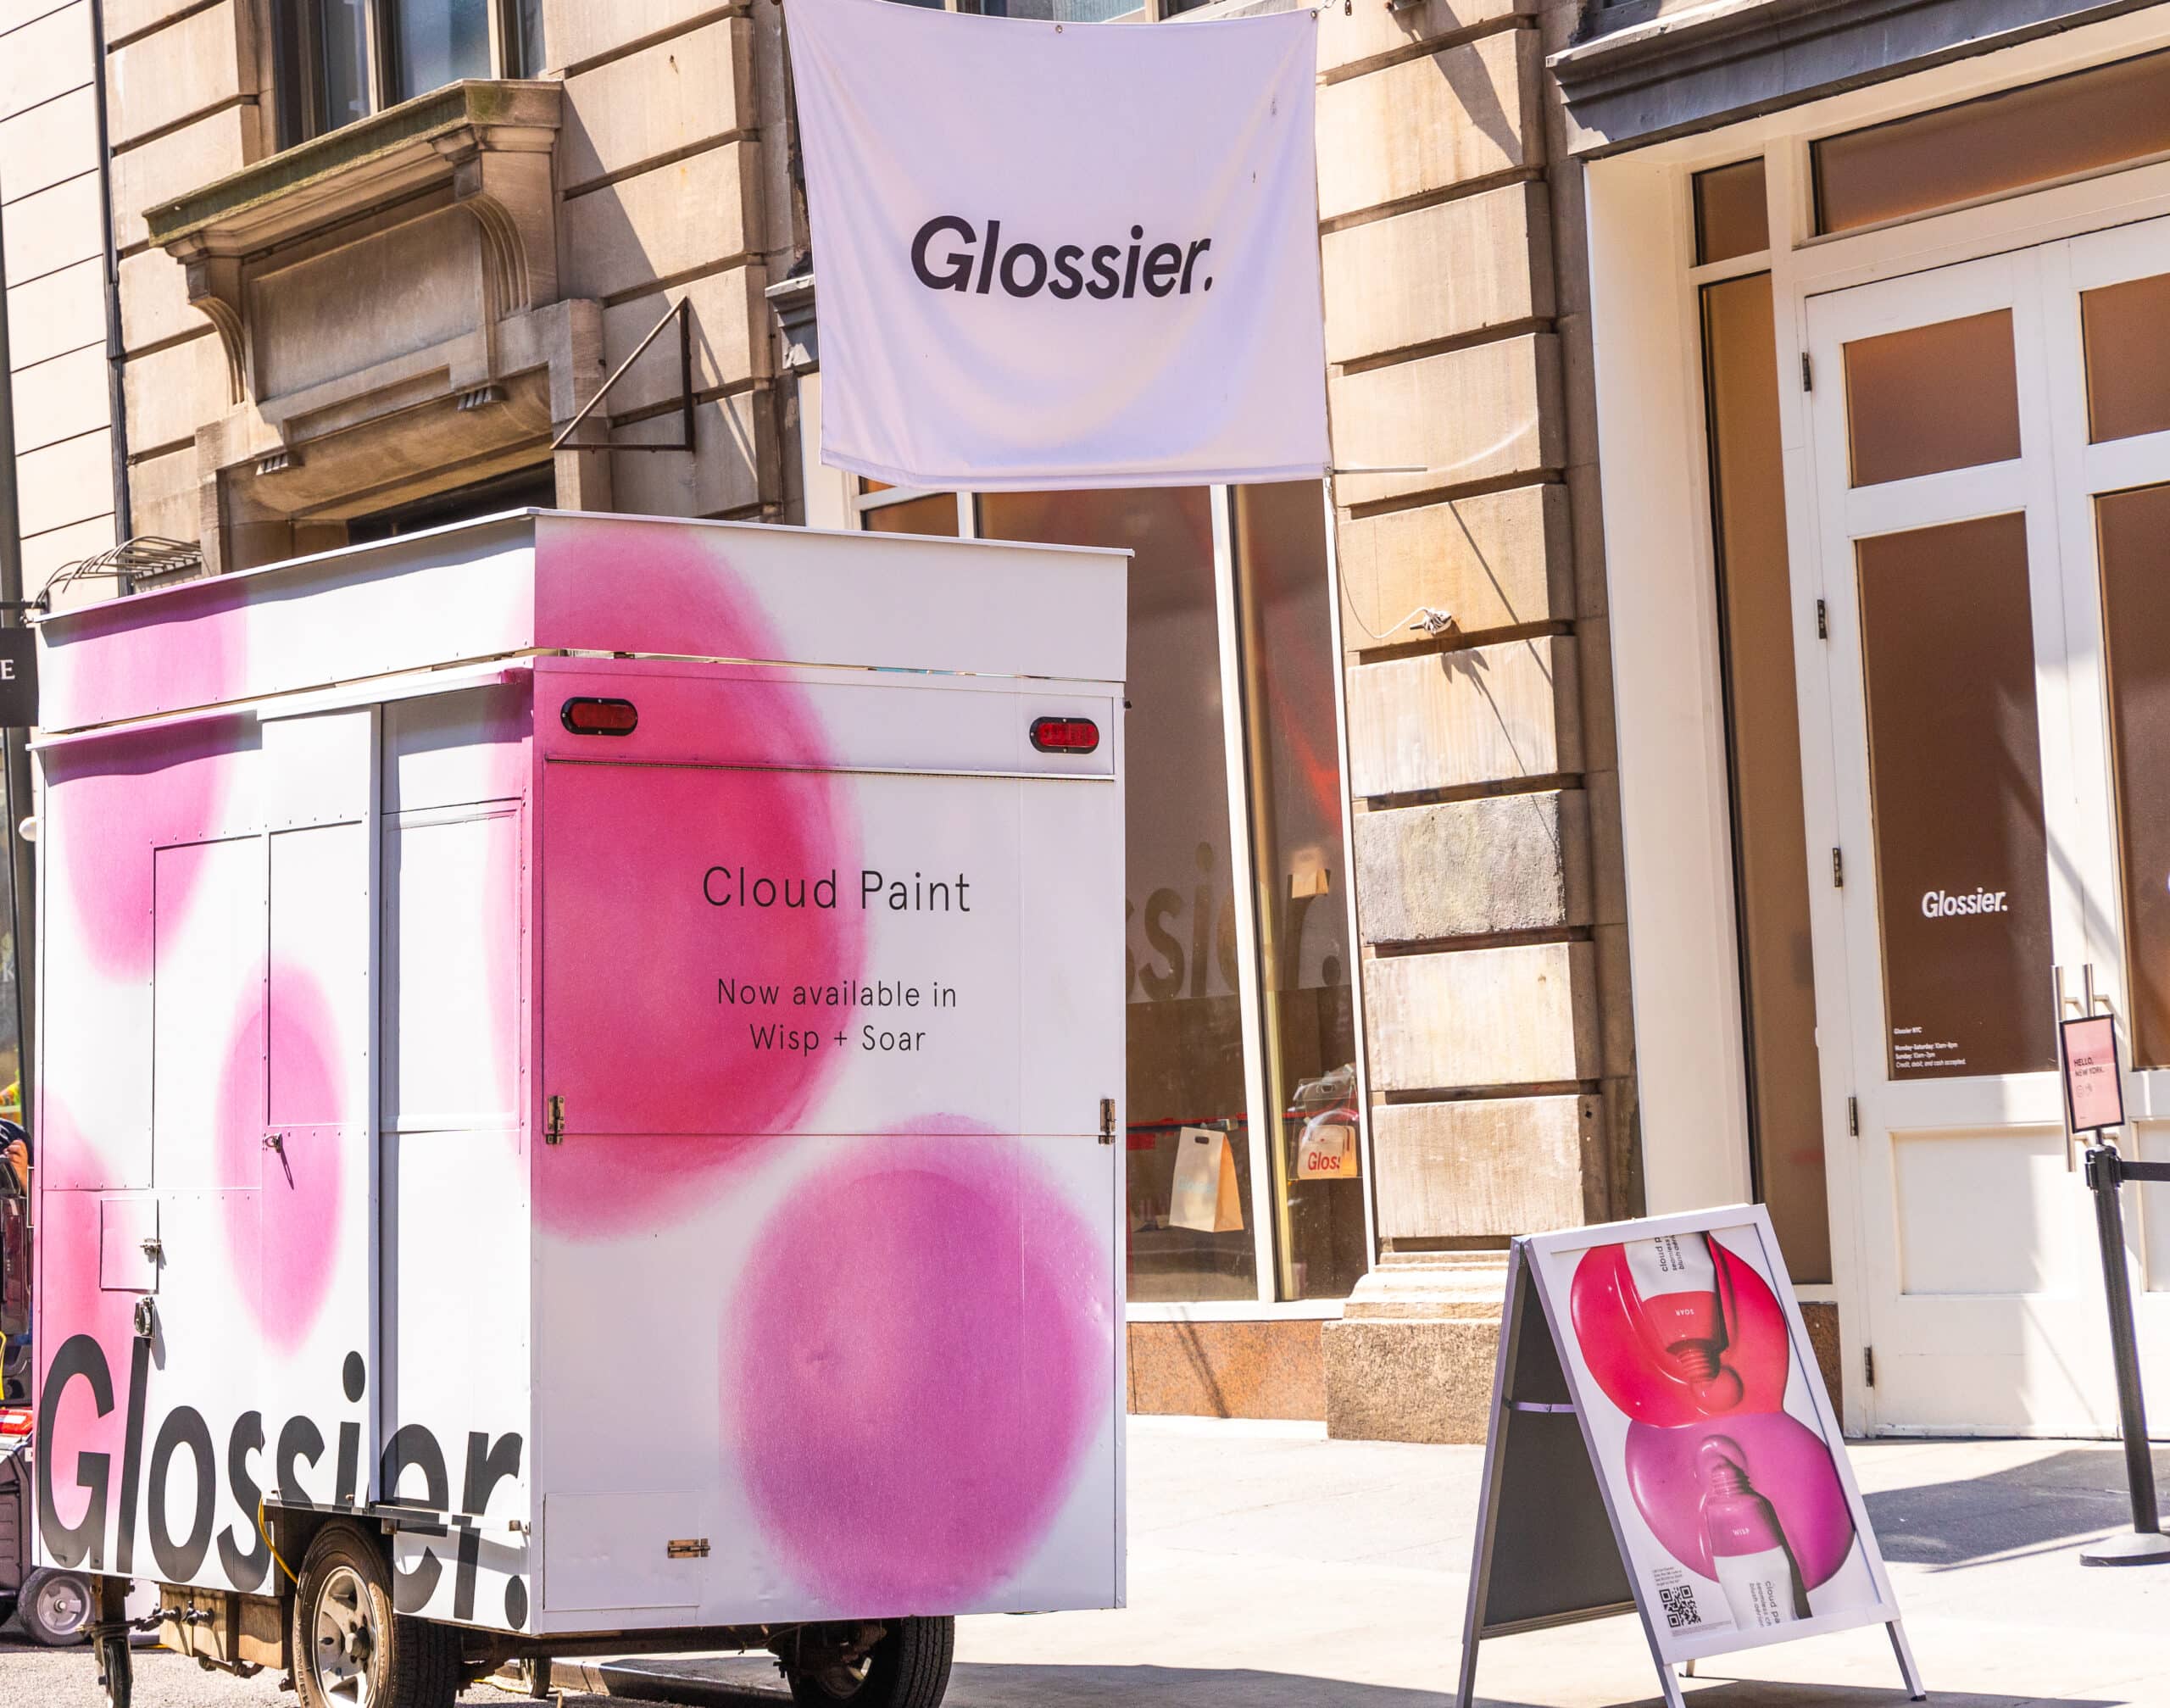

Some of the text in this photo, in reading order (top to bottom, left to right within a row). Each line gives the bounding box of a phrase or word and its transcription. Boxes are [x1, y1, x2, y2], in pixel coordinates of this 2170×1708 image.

[911, 215, 1213, 299] Glossier.
[703, 866, 971, 912] Cloud Paint
[1921, 887, 2008, 918] Glossier.
[718, 978, 957, 1007] Now available in
[750, 1024, 820, 1057] Wisp
[862, 1025, 926, 1051] Soar
[1655, 1245, 1668, 1271] cloud
[37, 1334, 528, 1630] Glossier.
[1765, 1581, 1778, 1608] cloud
